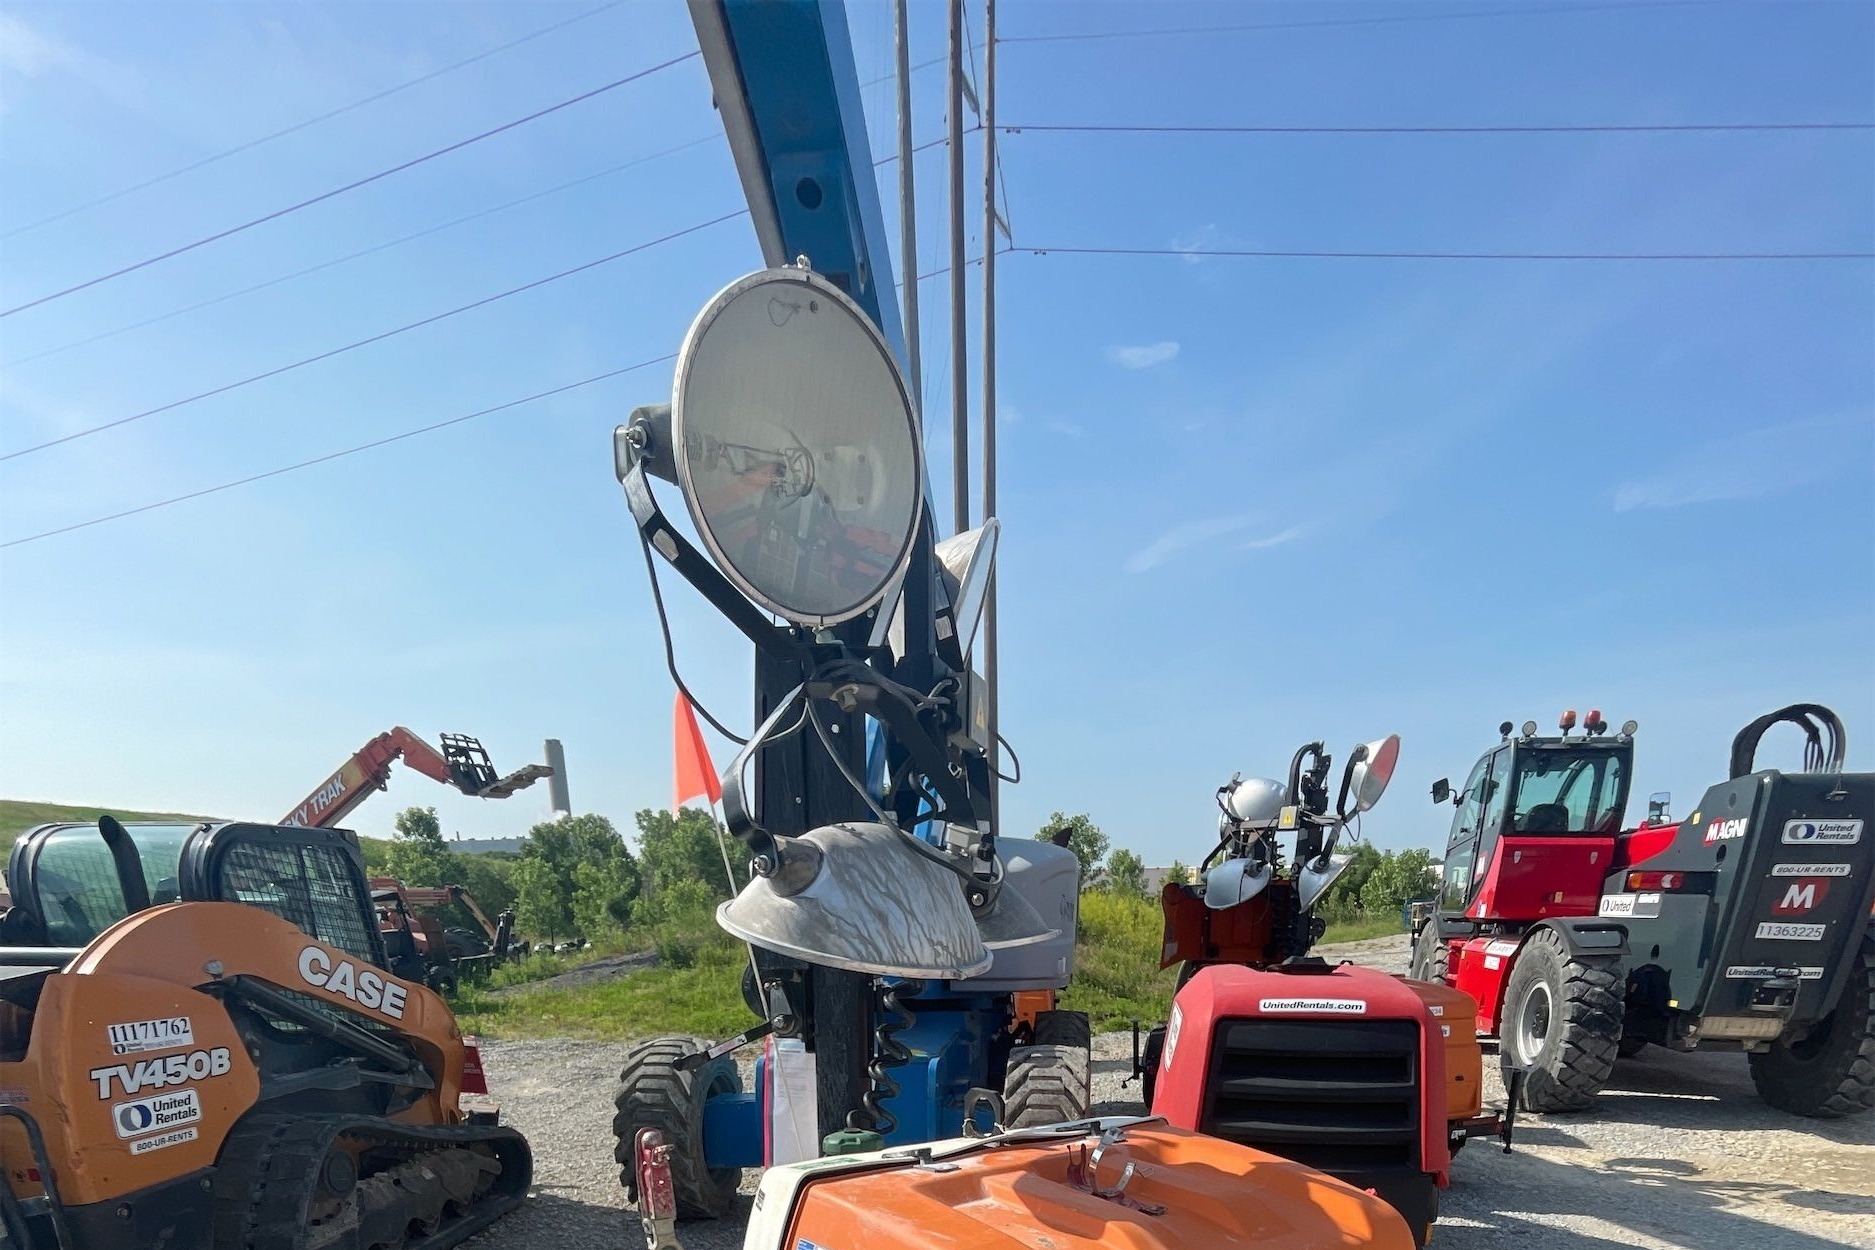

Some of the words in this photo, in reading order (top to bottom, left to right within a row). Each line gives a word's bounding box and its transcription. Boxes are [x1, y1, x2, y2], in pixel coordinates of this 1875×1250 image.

[310, 773, 347, 815] TRAK
[1705, 817, 1748, 842] MAGNI
[1815, 832, 1855, 840] Rentals
[1819, 823, 1855, 832] United
[1610, 899, 1633, 912] United
[1780, 884, 1815, 909] M
[1759, 925, 1823, 938] 11363225
[298, 945, 408, 1020] CASE
[1262, 1001, 1363, 1011] UnitedRentals.com
[110, 1018, 190, 1043] 11171762
[90, 1047, 231, 1100] TV450B
[153, 1094, 192, 1113] United
[155, 1106, 198, 1126] Rentals
[136, 1130, 193, 1152] 800-UR-RENTS
